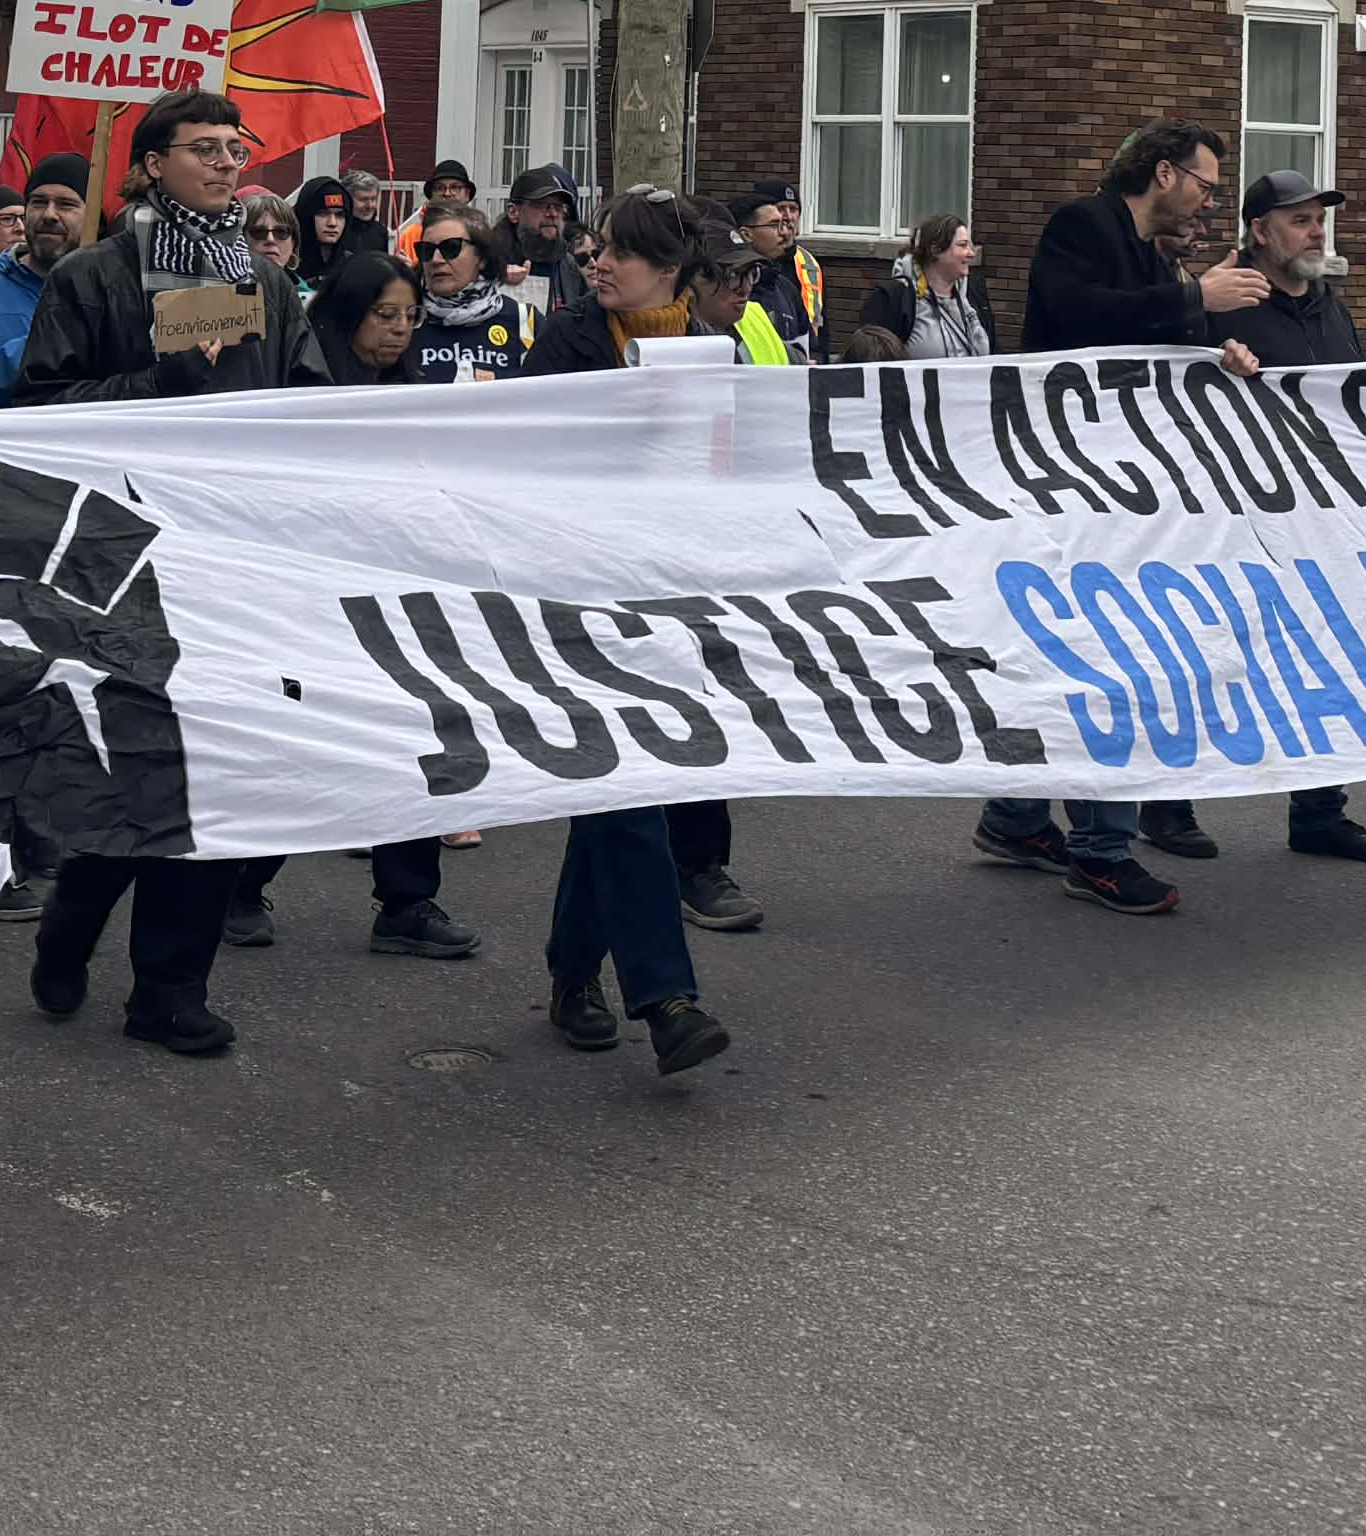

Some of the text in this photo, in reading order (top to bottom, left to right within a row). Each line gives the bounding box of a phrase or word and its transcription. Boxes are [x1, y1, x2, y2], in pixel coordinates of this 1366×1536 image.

[182, 24, 228, 58] DE
[41, 51, 204, 91] CHALEUR
[421, 342, 509, 367] polaire
[809, 367, 1012, 539] EN
[339, 577, 1049, 796] JUSTICE
